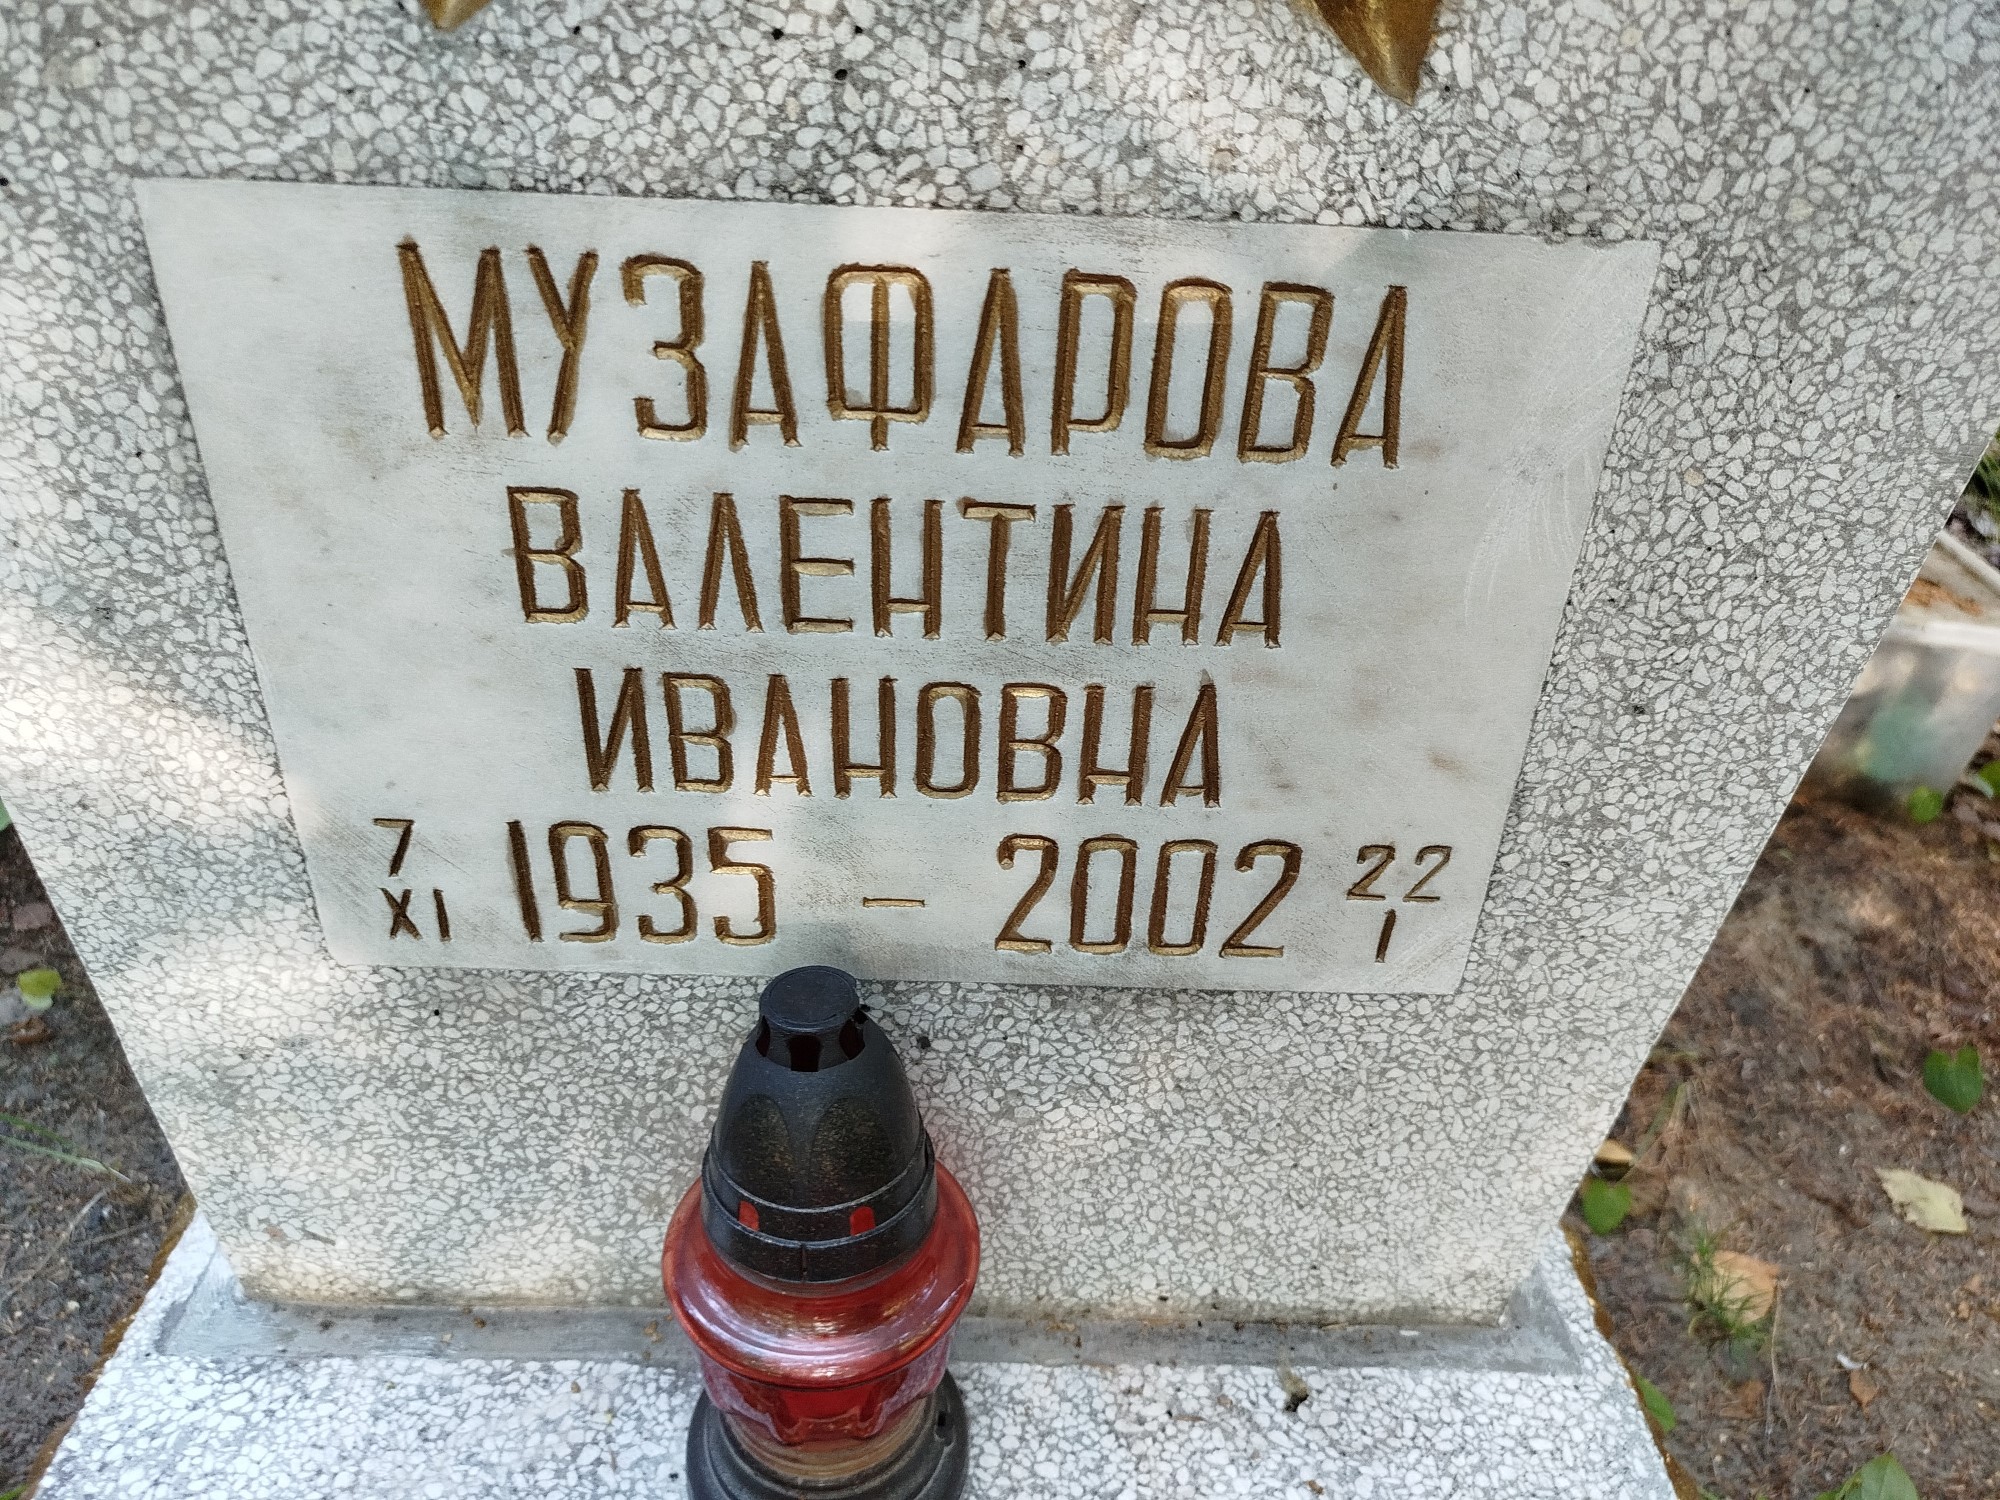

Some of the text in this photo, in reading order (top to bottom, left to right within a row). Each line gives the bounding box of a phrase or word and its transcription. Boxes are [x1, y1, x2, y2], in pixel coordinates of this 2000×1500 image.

[396, 235, 1408, 468] МУЗАФАРОВА
[508, 485, 1282, 648] ВАЛЕНТИНА
[574, 667, 1223, 808] ИВАНОВНА
[372, 816, 416, 878] 7
[506, 819, 777, 946] 1935
[993, 832, 1302, 959] 2002
[1346, 843, 1453, 903] 22
